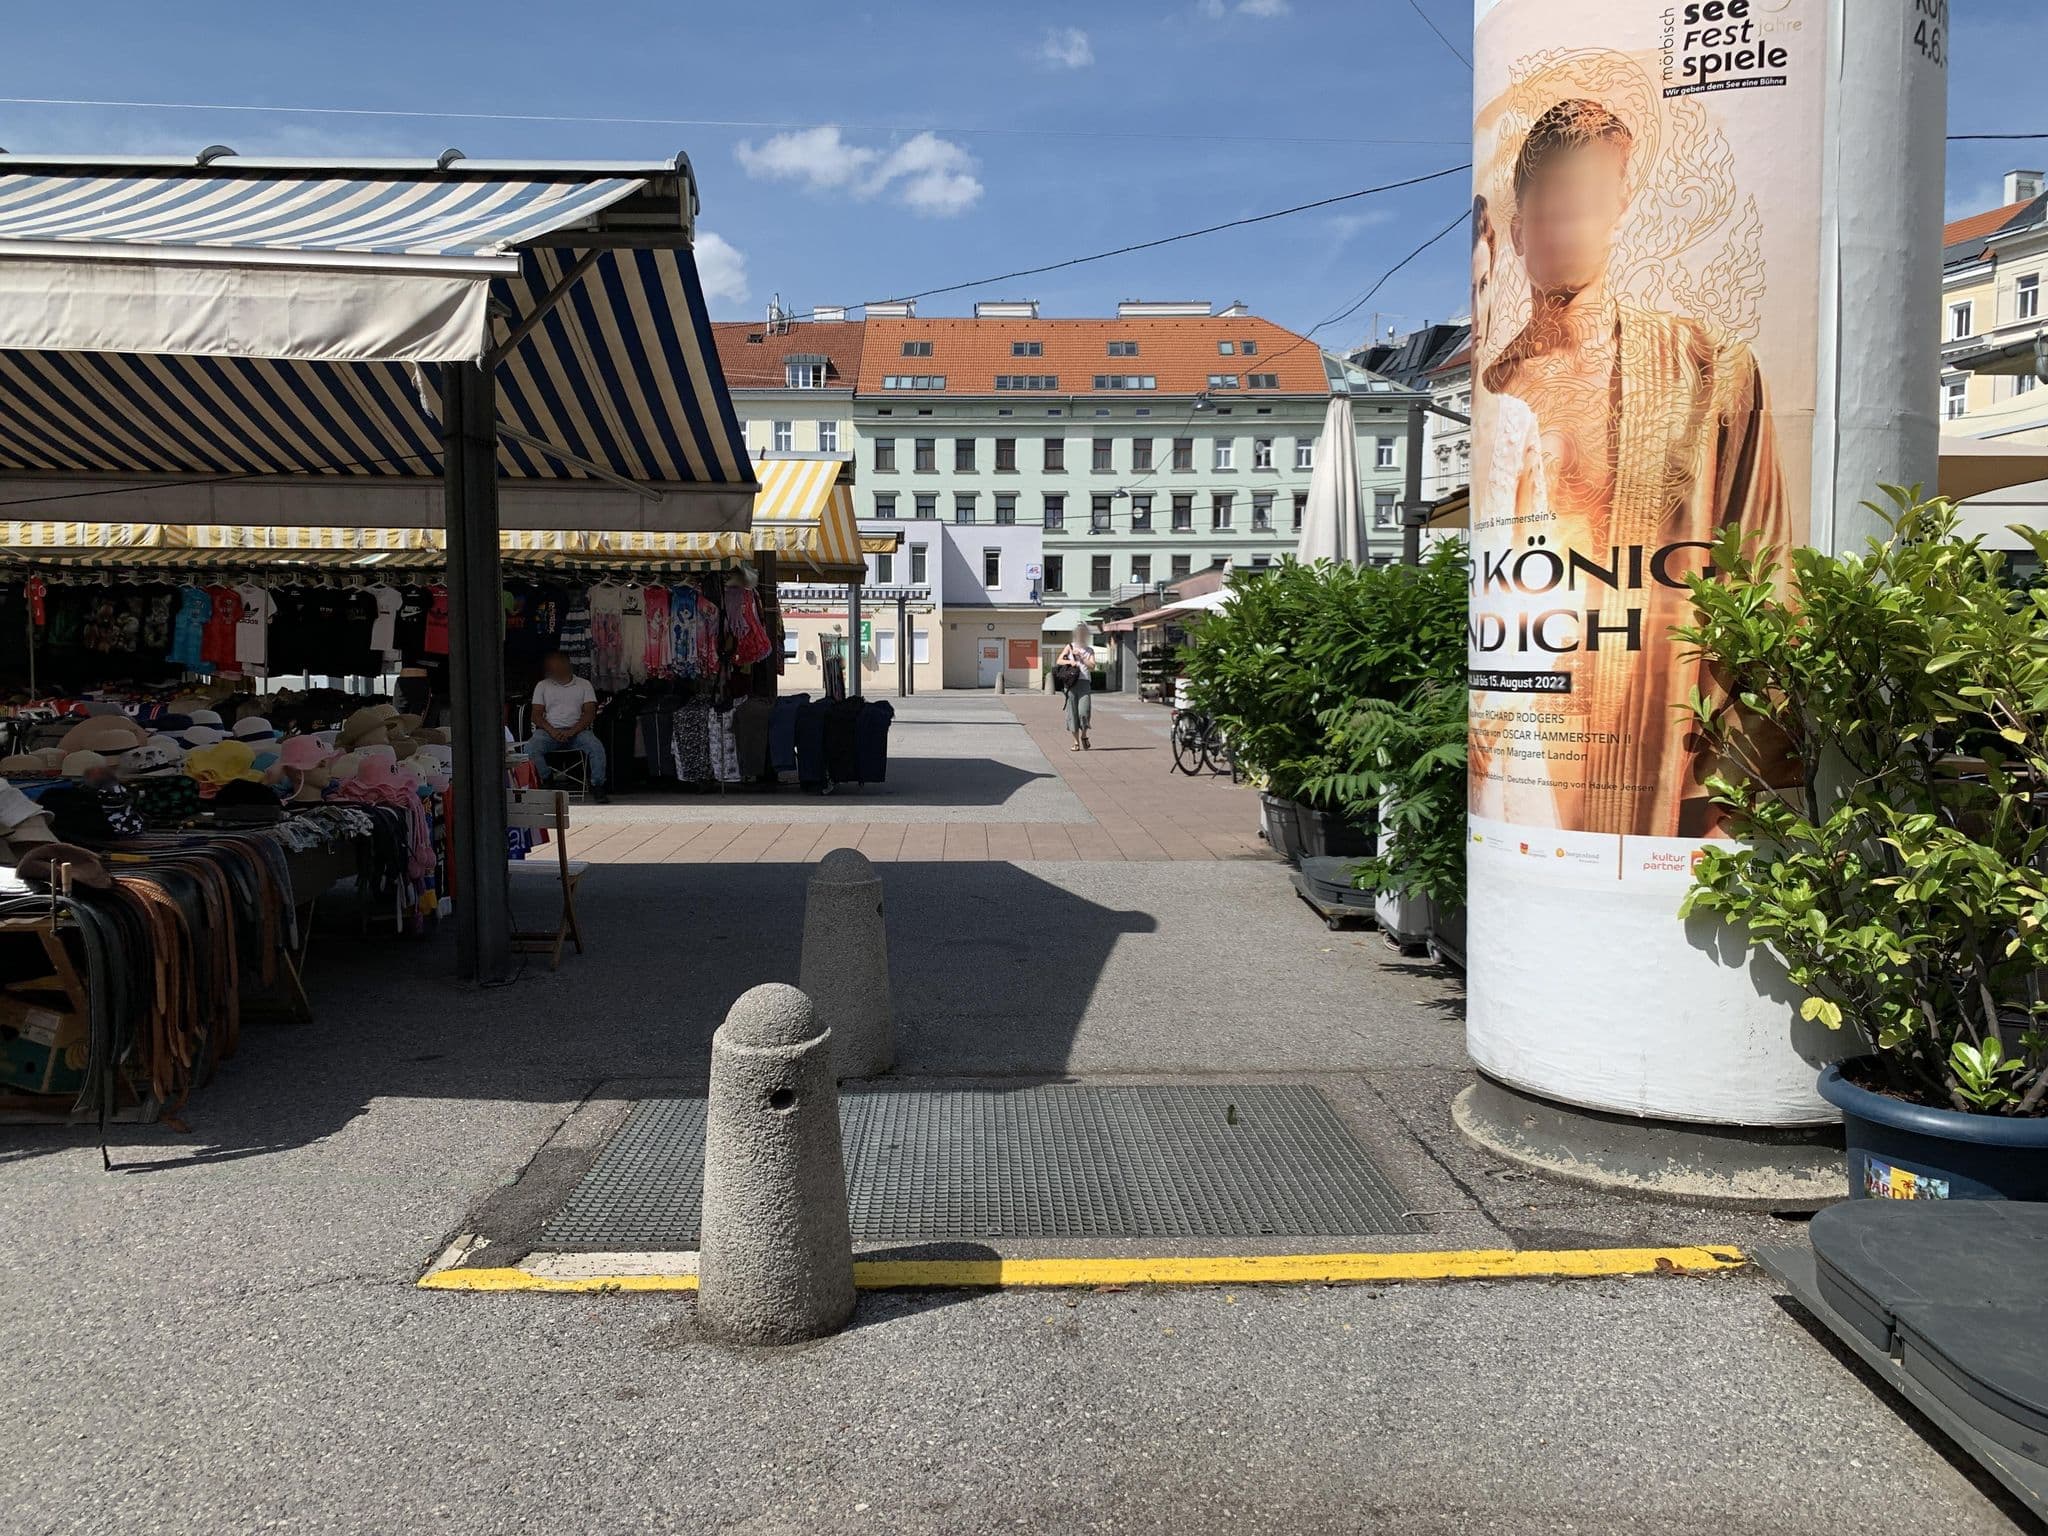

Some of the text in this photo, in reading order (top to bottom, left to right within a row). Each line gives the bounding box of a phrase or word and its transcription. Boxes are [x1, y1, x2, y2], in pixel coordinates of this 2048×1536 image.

[1684, 0, 1750, 25] see
[1758, 18, 1803, 37] jahre
[1658, 7, 1675, 80] mörbisch
[1682, 40, 1788, 84] spiele
[1665, 77, 1784, 97] Wir geben dem See eine Bühne
[1496, 511, 1557, 527] Hammerstein's
[1483, 534, 1716, 595] KÖNIG
[1518, 608, 1642, 653] ICH
[1489, 675, 1499, 687] 15.
[1500, 675, 1533, 691] August
[1535, 676, 1567, 689] 2022
[1485, 710, 1515, 722] RICHARD
[1516, 712, 1565, 724] RODGERS
[1502, 728, 1532, 740] OSCAR
[1533, 730, 1620, 744] HAMMERSTEIN
[1624, 734, 1631, 744] II
[1507, 747, 1545, 761] Margaret
[1547, 749, 1588, 761] Landon
[1507, 774, 1536, 785] Deutsche
[1537, 777, 1568, 789] Fassung
[1570, 781, 1586, 789] von
[1589, 782, 1618, 791] Hauke
[1620, 783, 1654, 792] Jensen
[1652, 852, 1686, 862] kultur
[1642, 862, 1685, 871] partner
